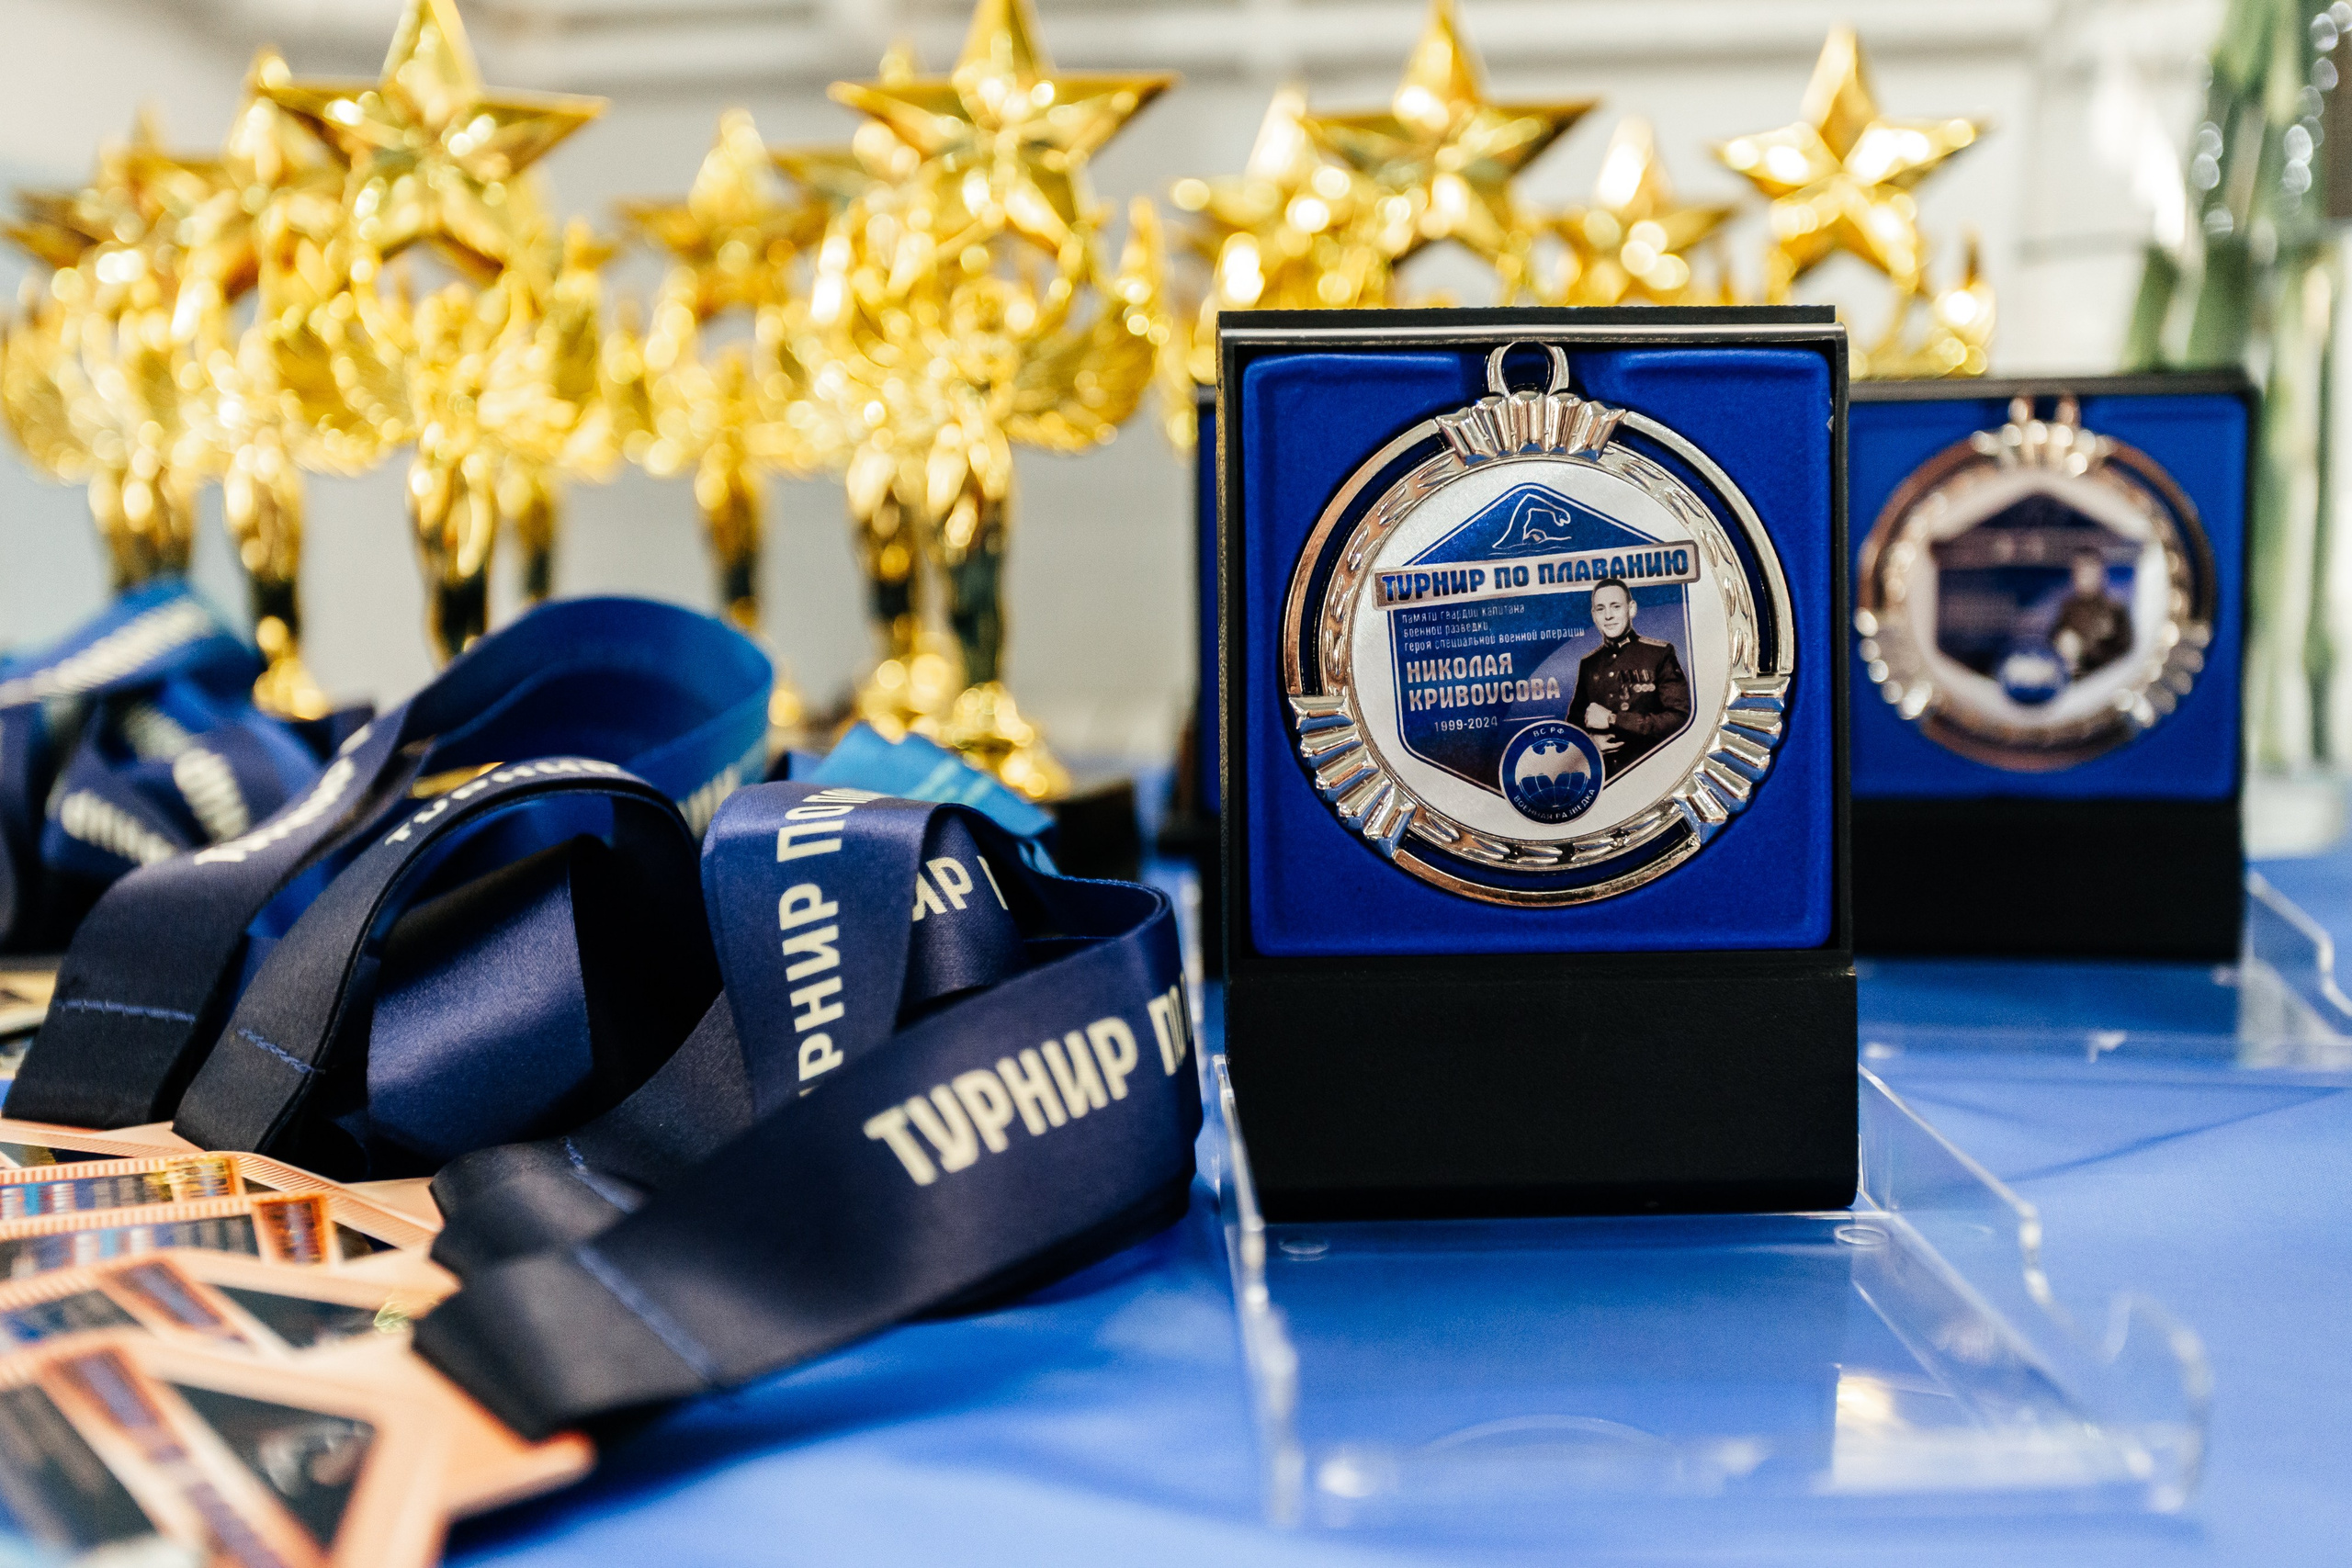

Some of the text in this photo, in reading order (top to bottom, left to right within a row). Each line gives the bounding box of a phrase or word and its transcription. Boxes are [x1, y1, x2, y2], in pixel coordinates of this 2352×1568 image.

[1382, 549, 1689, 602] ТУРНИР ПО ПЛАВАНИЮ
[1441, 608, 1479, 621] гвардии
[1481, 604, 1525, 618] капитана
[1404, 627, 1585, 654] героя специальной военной операции
[1406, 652, 1513, 683] НИКОЛАЯ
[1408, 677, 1561, 712] КРИВОУСОВА
[1434, 716, 1498, 732] 1999-2024
[1532, 727, 1565, 738] ВС РФ
[778, 883, 844, 1097] РНИР
[863, 1016, 1138, 1186] ТУРНИР
